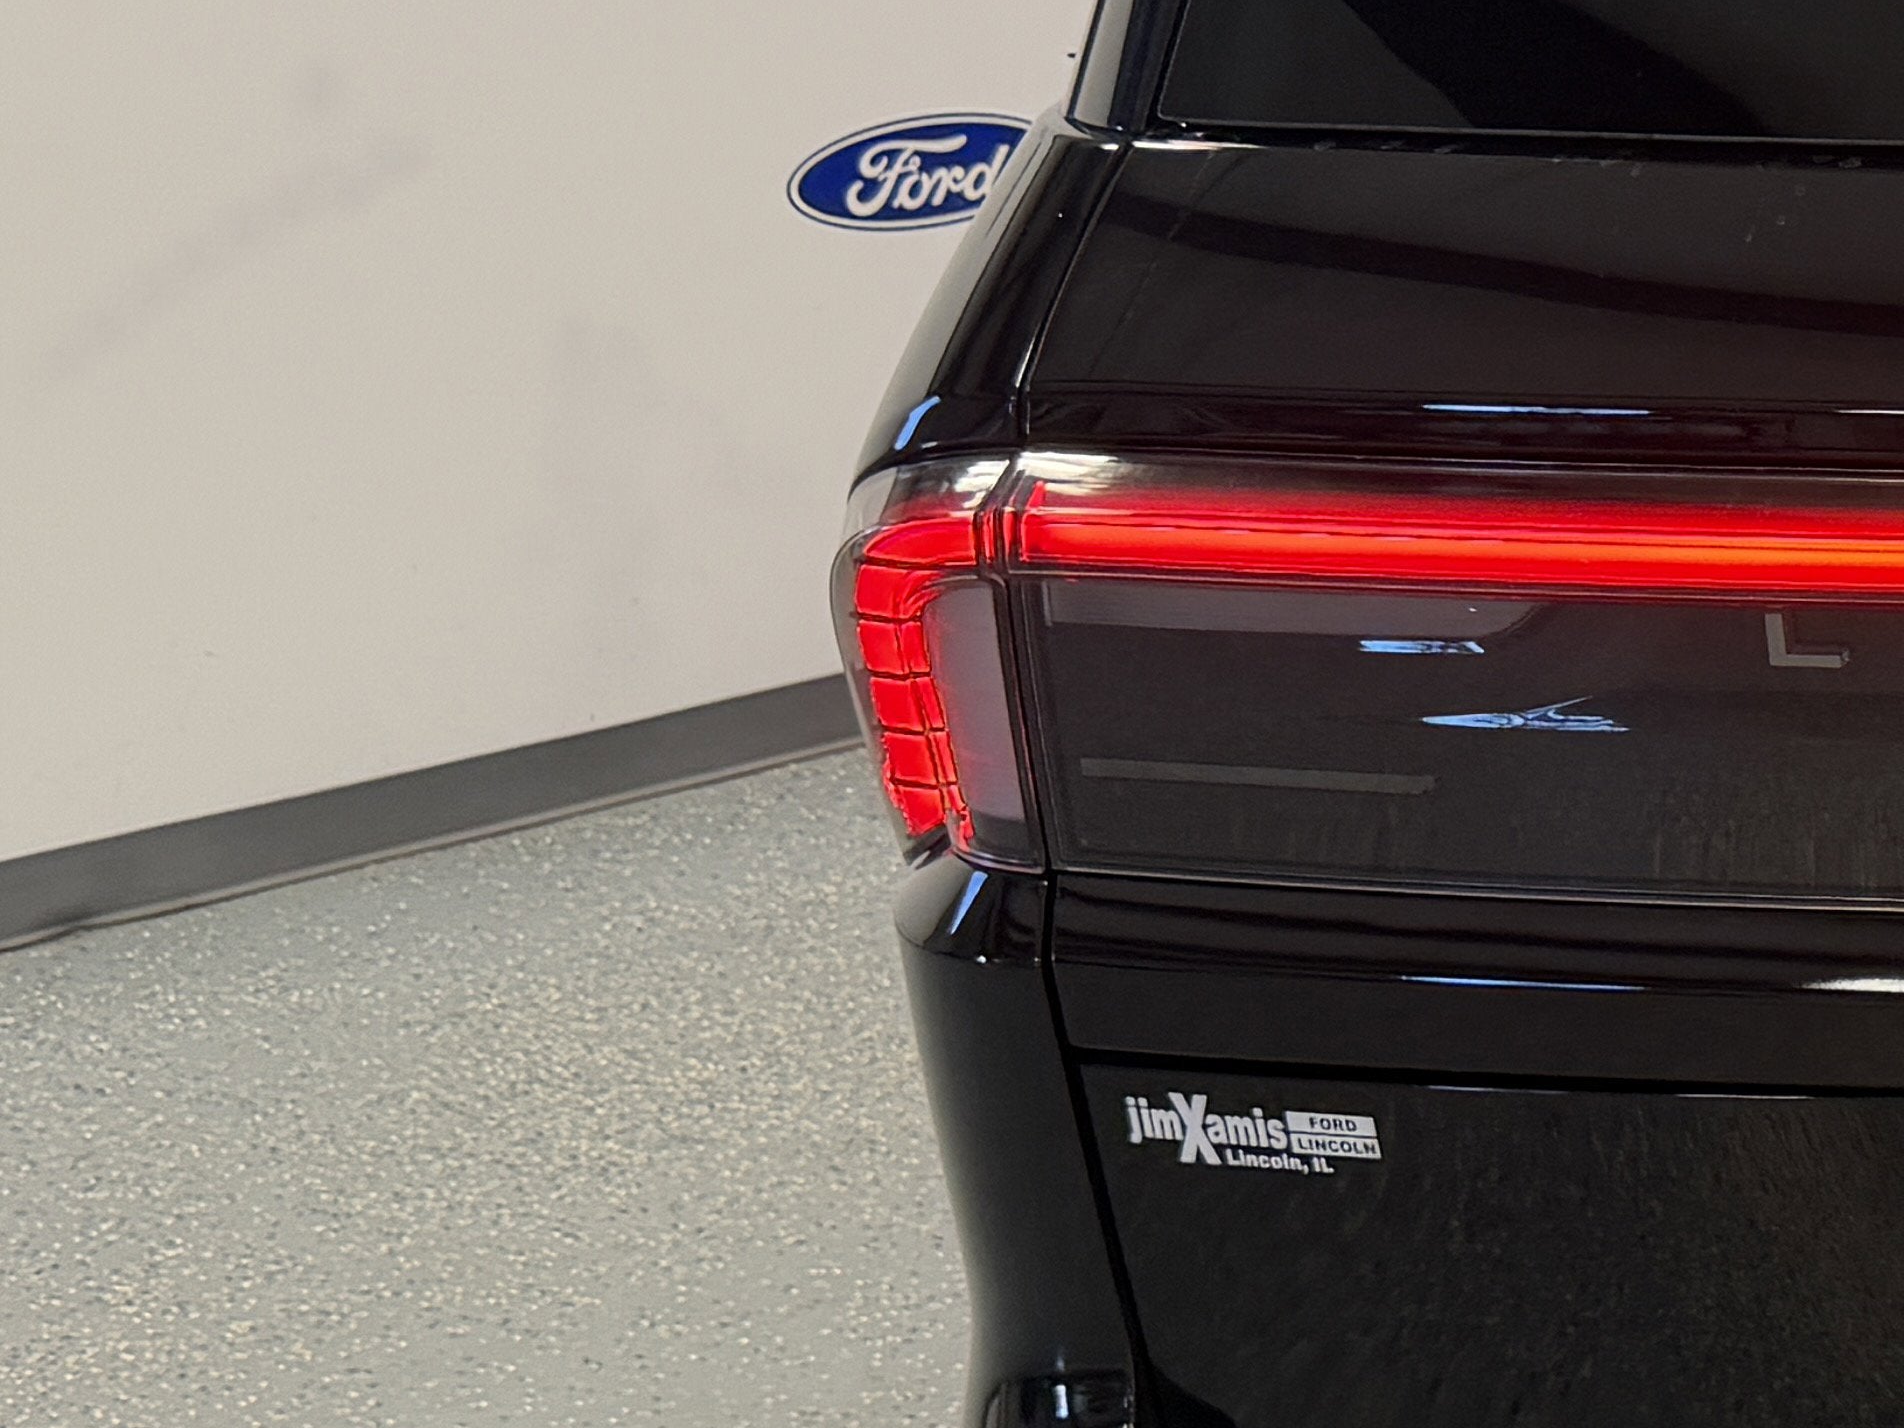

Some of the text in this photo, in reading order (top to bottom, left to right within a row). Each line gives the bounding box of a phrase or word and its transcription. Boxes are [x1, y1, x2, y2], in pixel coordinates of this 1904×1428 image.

[1309, 1116, 1357, 1132] FORD
[1298, 1137, 1376, 1155] LINCOLN
[1226, 1149, 1309, 1175] Lincoln,
